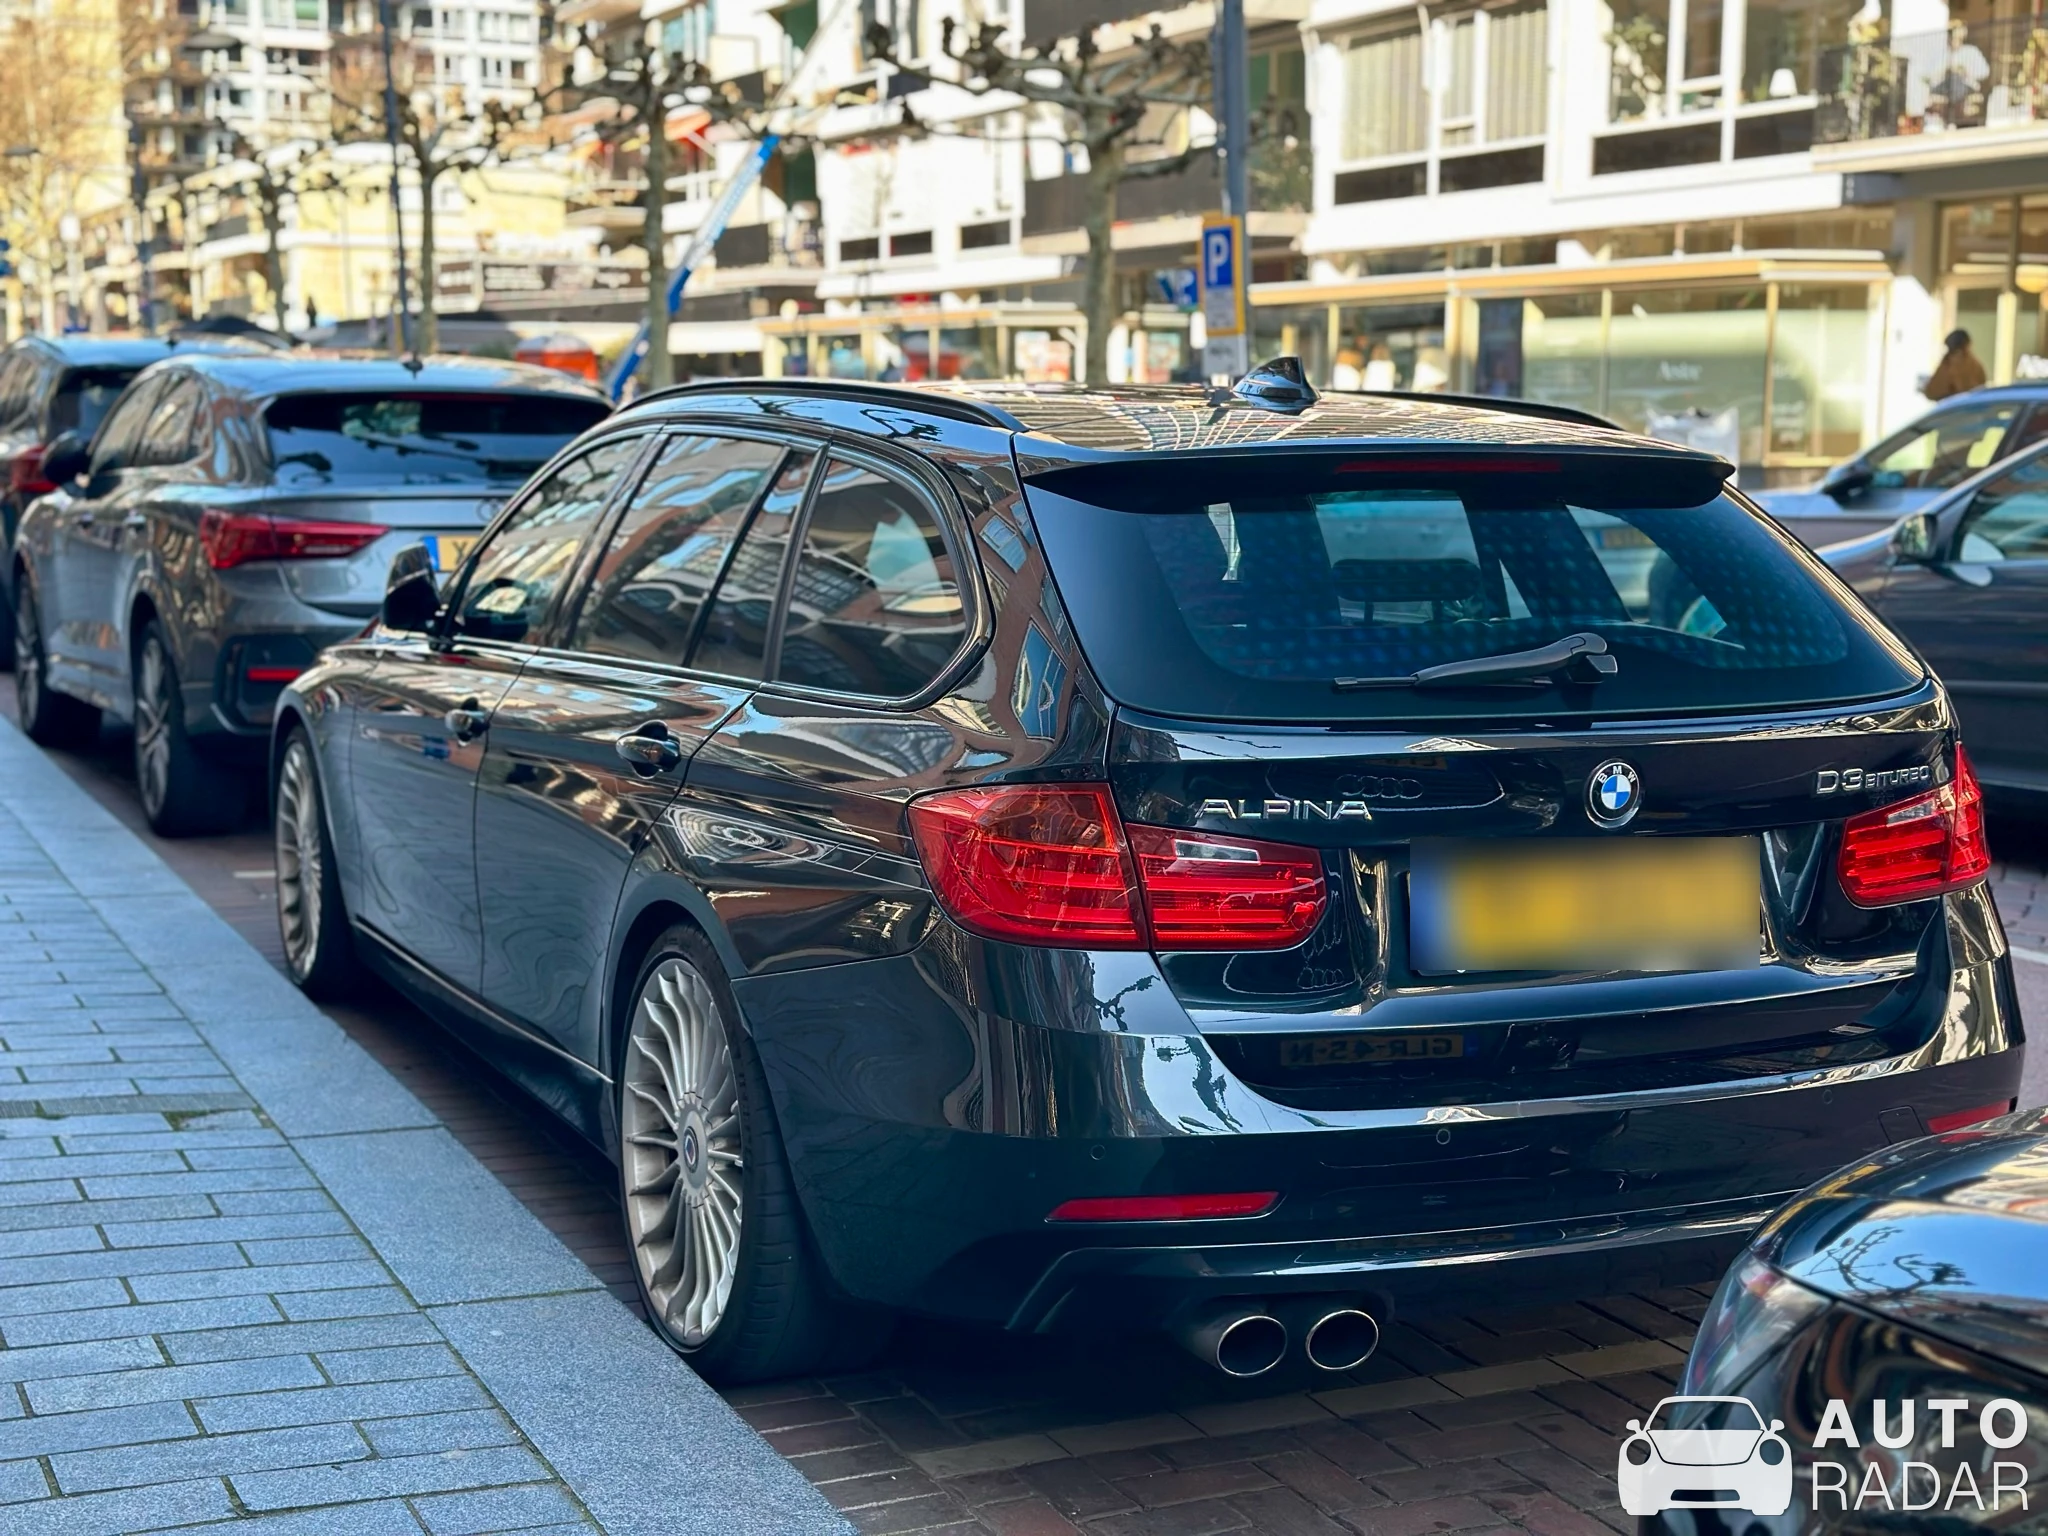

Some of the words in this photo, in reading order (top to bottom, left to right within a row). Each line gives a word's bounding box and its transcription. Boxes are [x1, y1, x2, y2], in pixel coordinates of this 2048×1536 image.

[1208, 234, 1229, 284] P
[1597, 766, 1636, 783] BMW
[1816, 768, 1863, 794] D3
[1195, 798, 1373, 821] ALPINA
